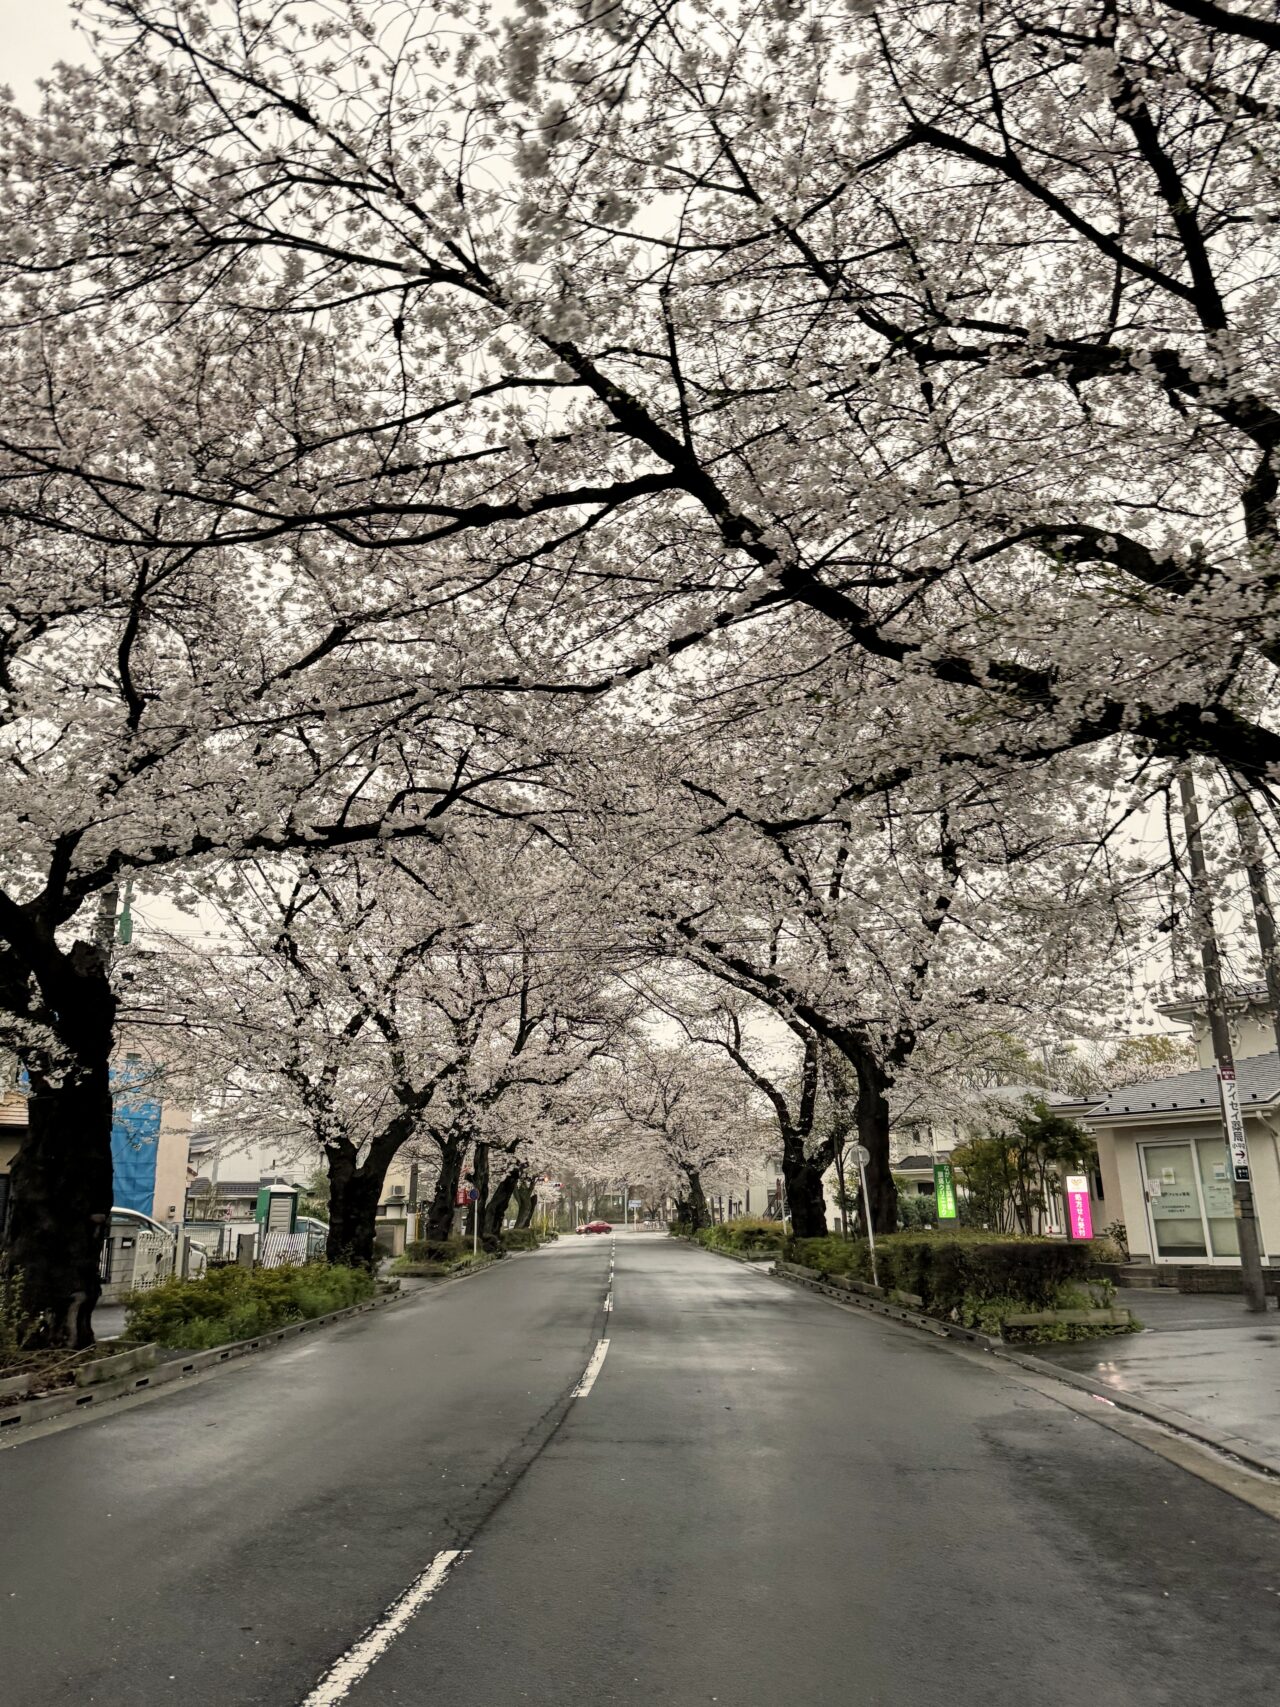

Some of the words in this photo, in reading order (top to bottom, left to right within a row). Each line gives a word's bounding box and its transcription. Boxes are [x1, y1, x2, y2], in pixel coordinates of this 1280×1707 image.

[1225, 1082, 1244, 1142] アイセイ薬局
